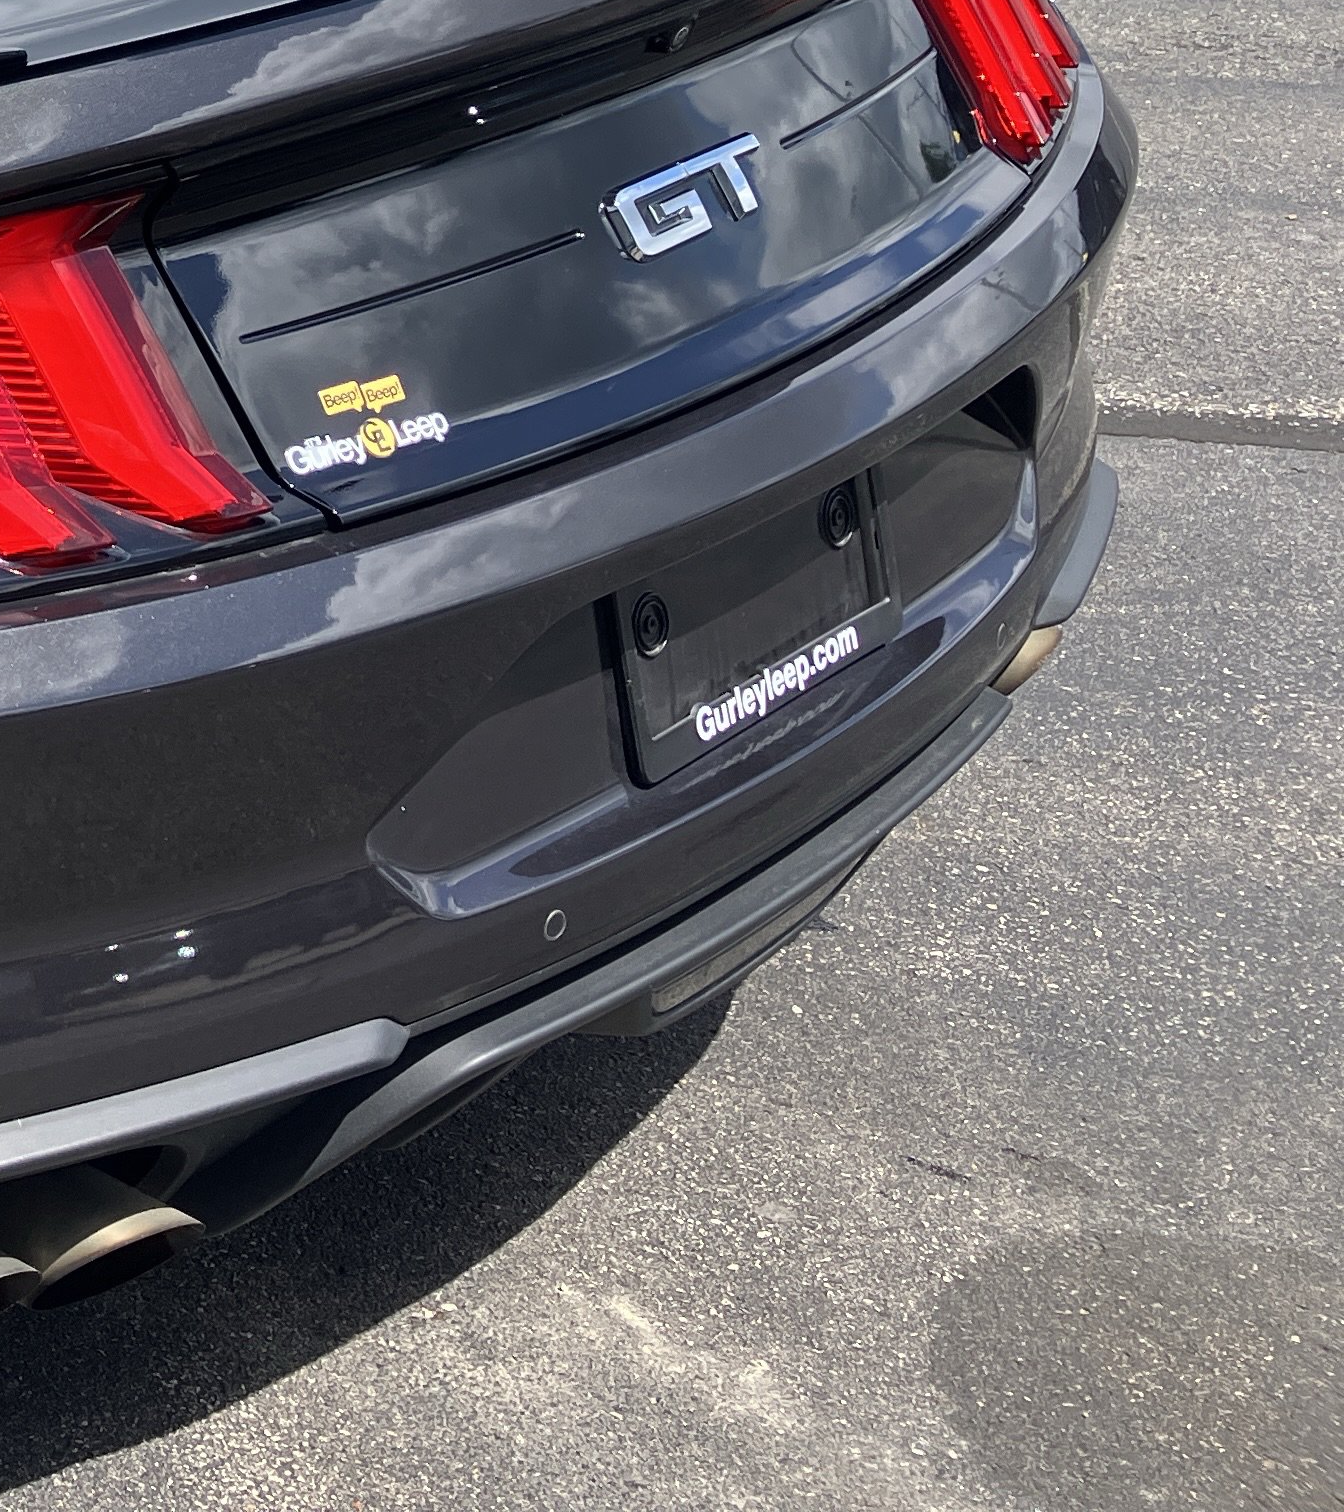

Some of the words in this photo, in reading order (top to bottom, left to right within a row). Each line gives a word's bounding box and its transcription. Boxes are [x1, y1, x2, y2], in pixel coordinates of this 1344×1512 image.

[598, 131, 760, 264] GT
[323, 387, 360, 409] Beep!
[366, 381, 402, 402] Beep!
[388, 412, 450, 448] Leep
[696, 625, 859, 741] Gurleyleep.com
